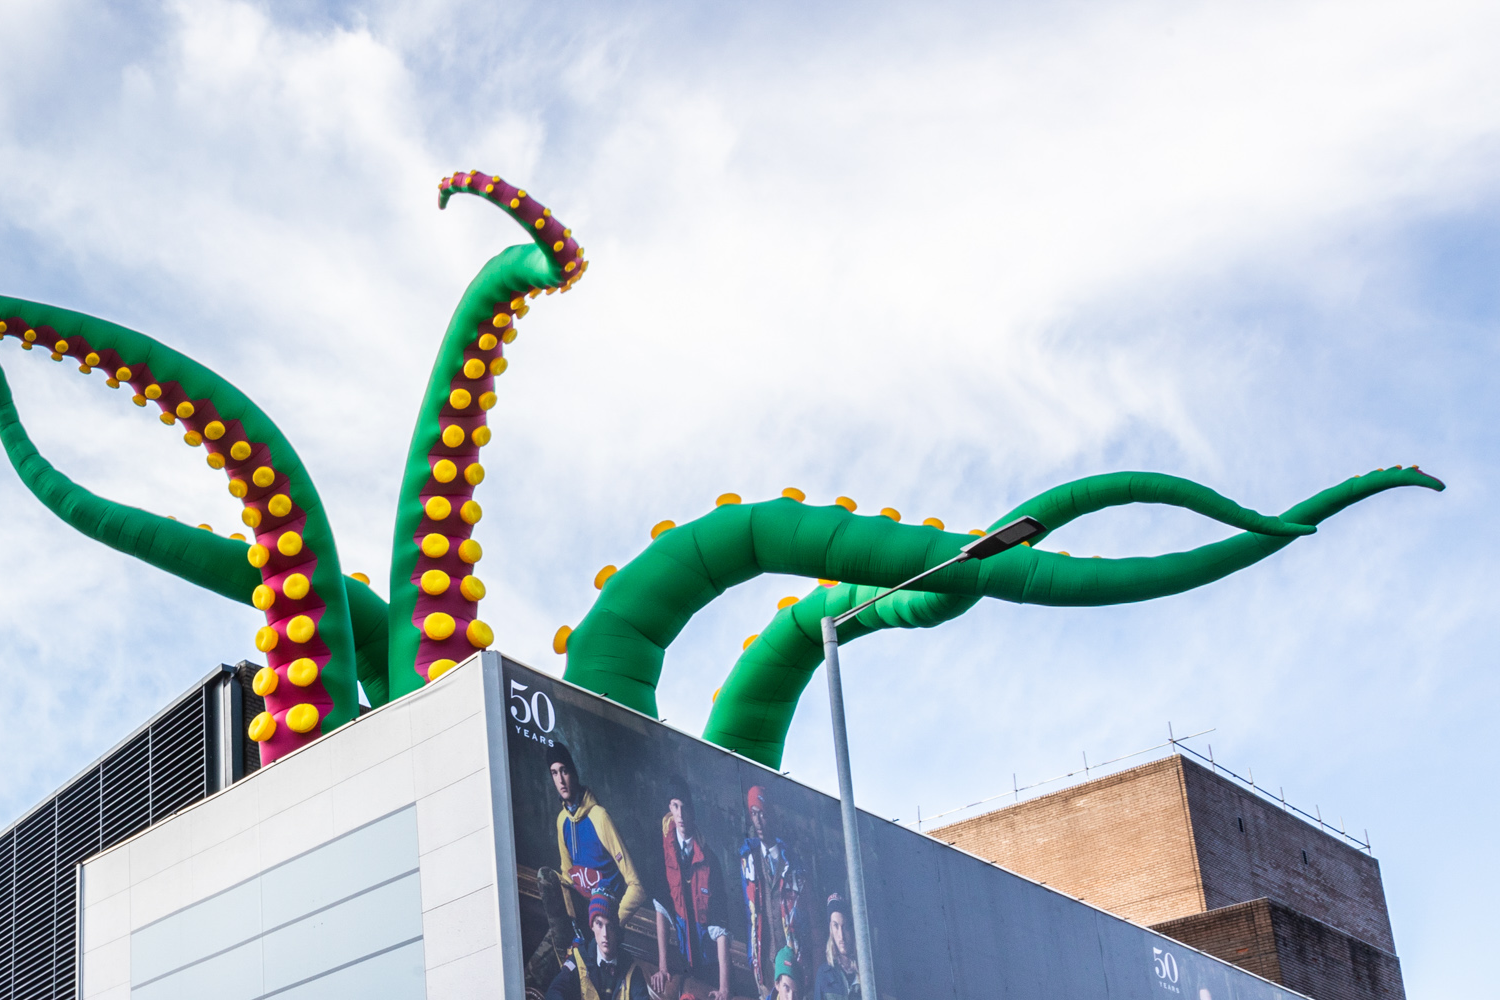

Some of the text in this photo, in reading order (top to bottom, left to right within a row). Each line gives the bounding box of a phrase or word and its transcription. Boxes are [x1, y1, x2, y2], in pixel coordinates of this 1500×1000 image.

[510, 679, 556, 733] 50
[516, 726, 554, 748] YEARS
[1153, 947, 1178, 984] 50
